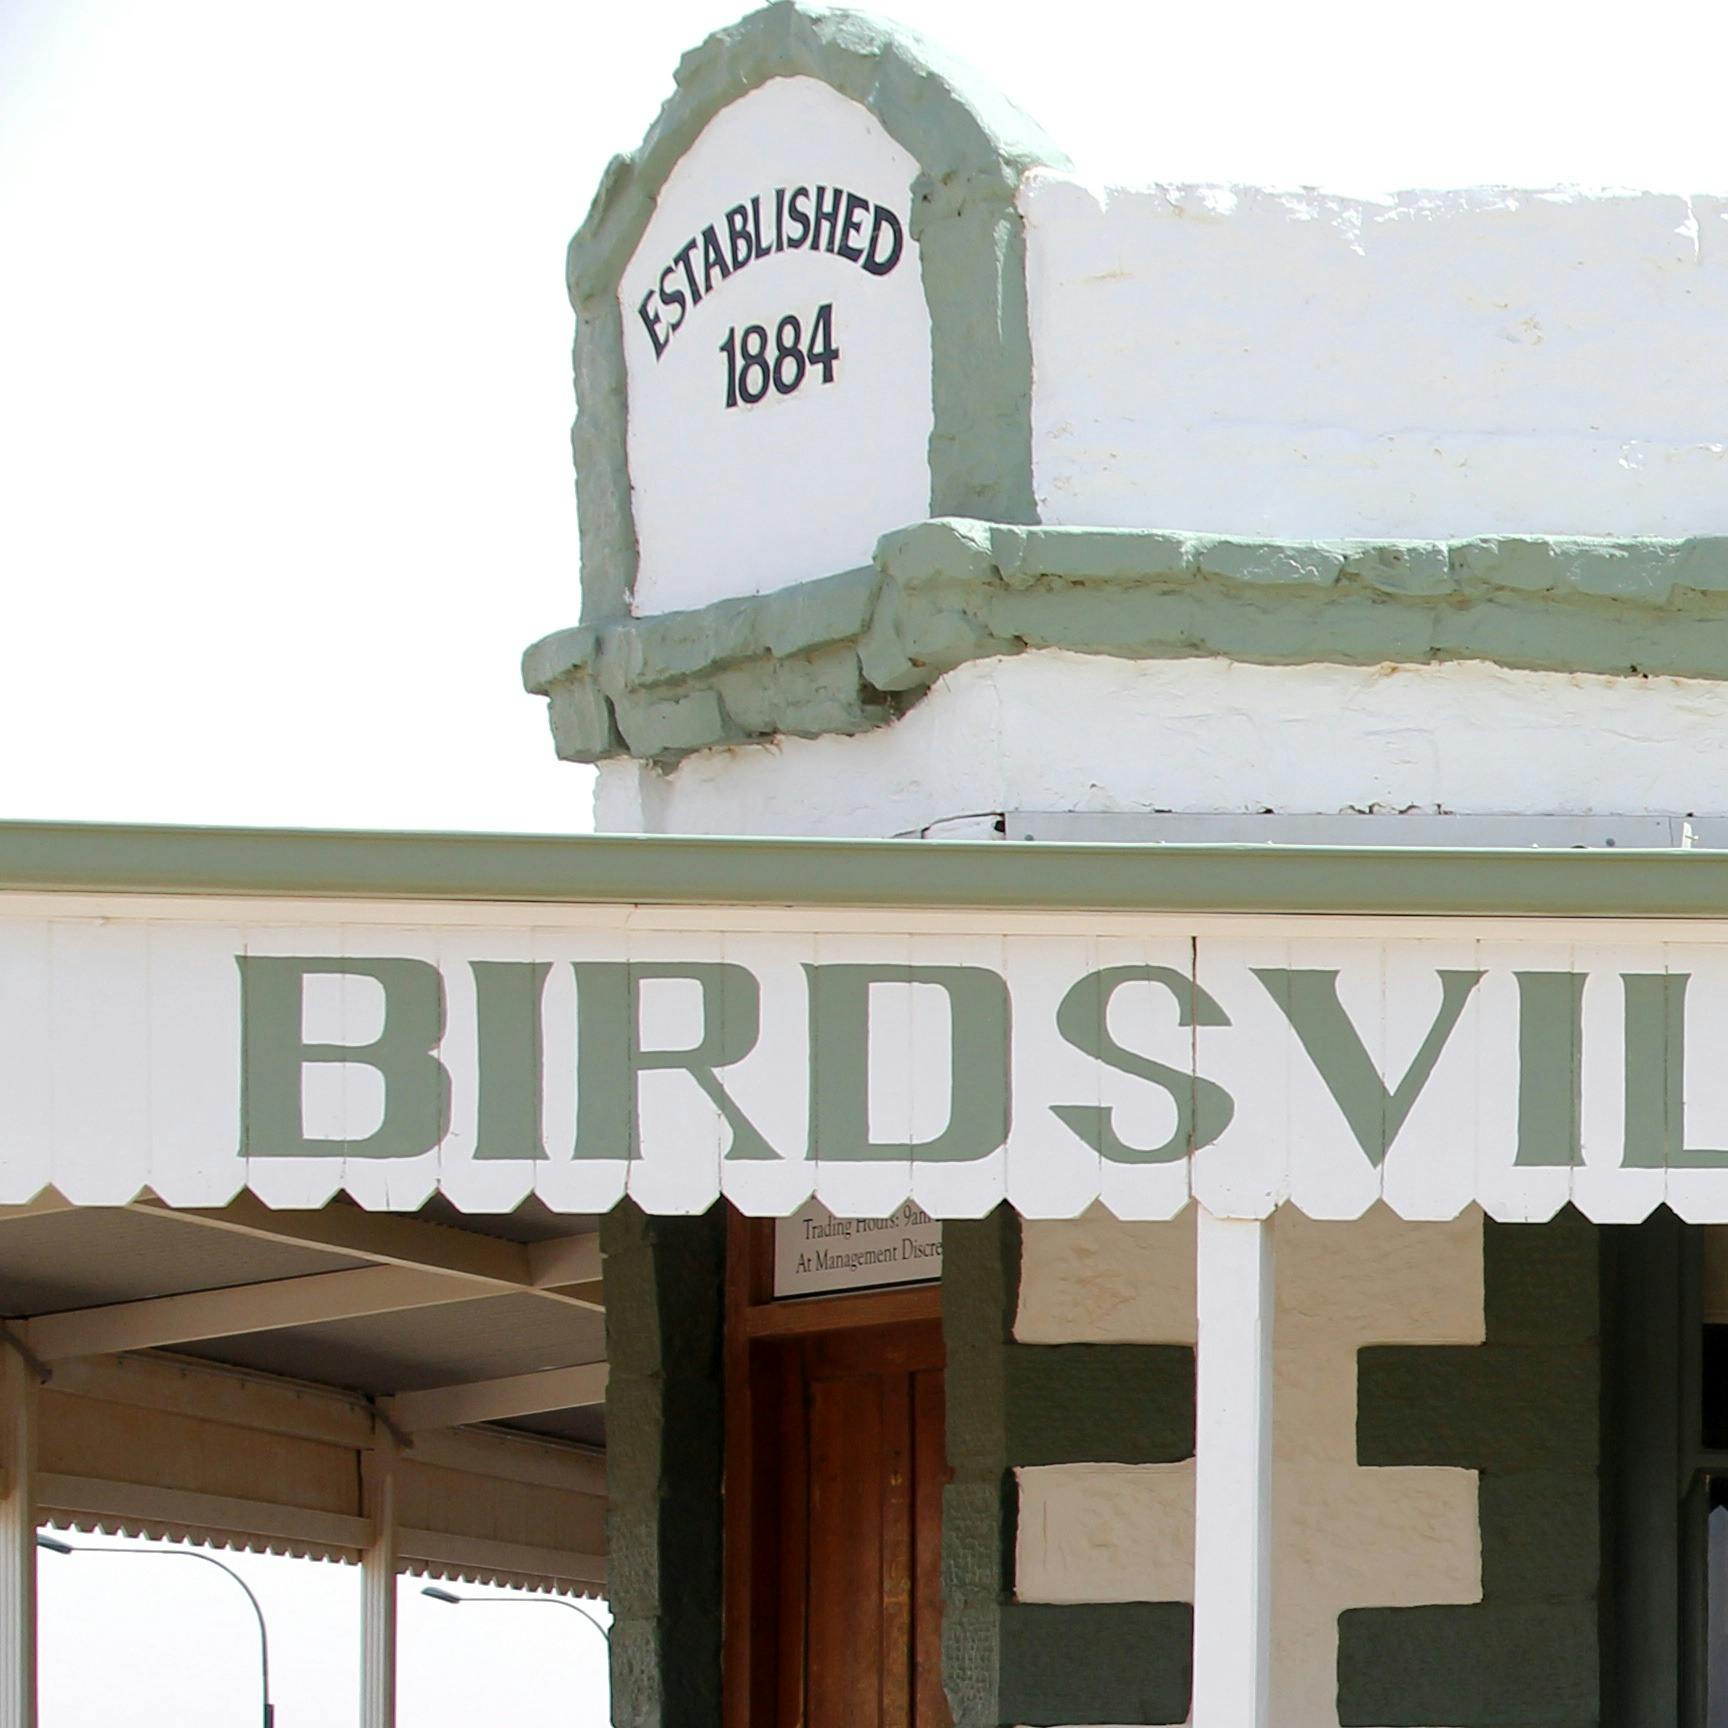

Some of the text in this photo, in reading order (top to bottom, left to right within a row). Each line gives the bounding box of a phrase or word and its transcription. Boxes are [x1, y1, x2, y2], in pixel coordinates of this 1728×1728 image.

[638, 185, 904, 361] ESTABLISHED
[718, 303, 839, 408] 1884
[795, 1252, 812, 1274] At
[815, 1247, 898, 1272] Management
[803, 1215, 852, 1240] Trading
